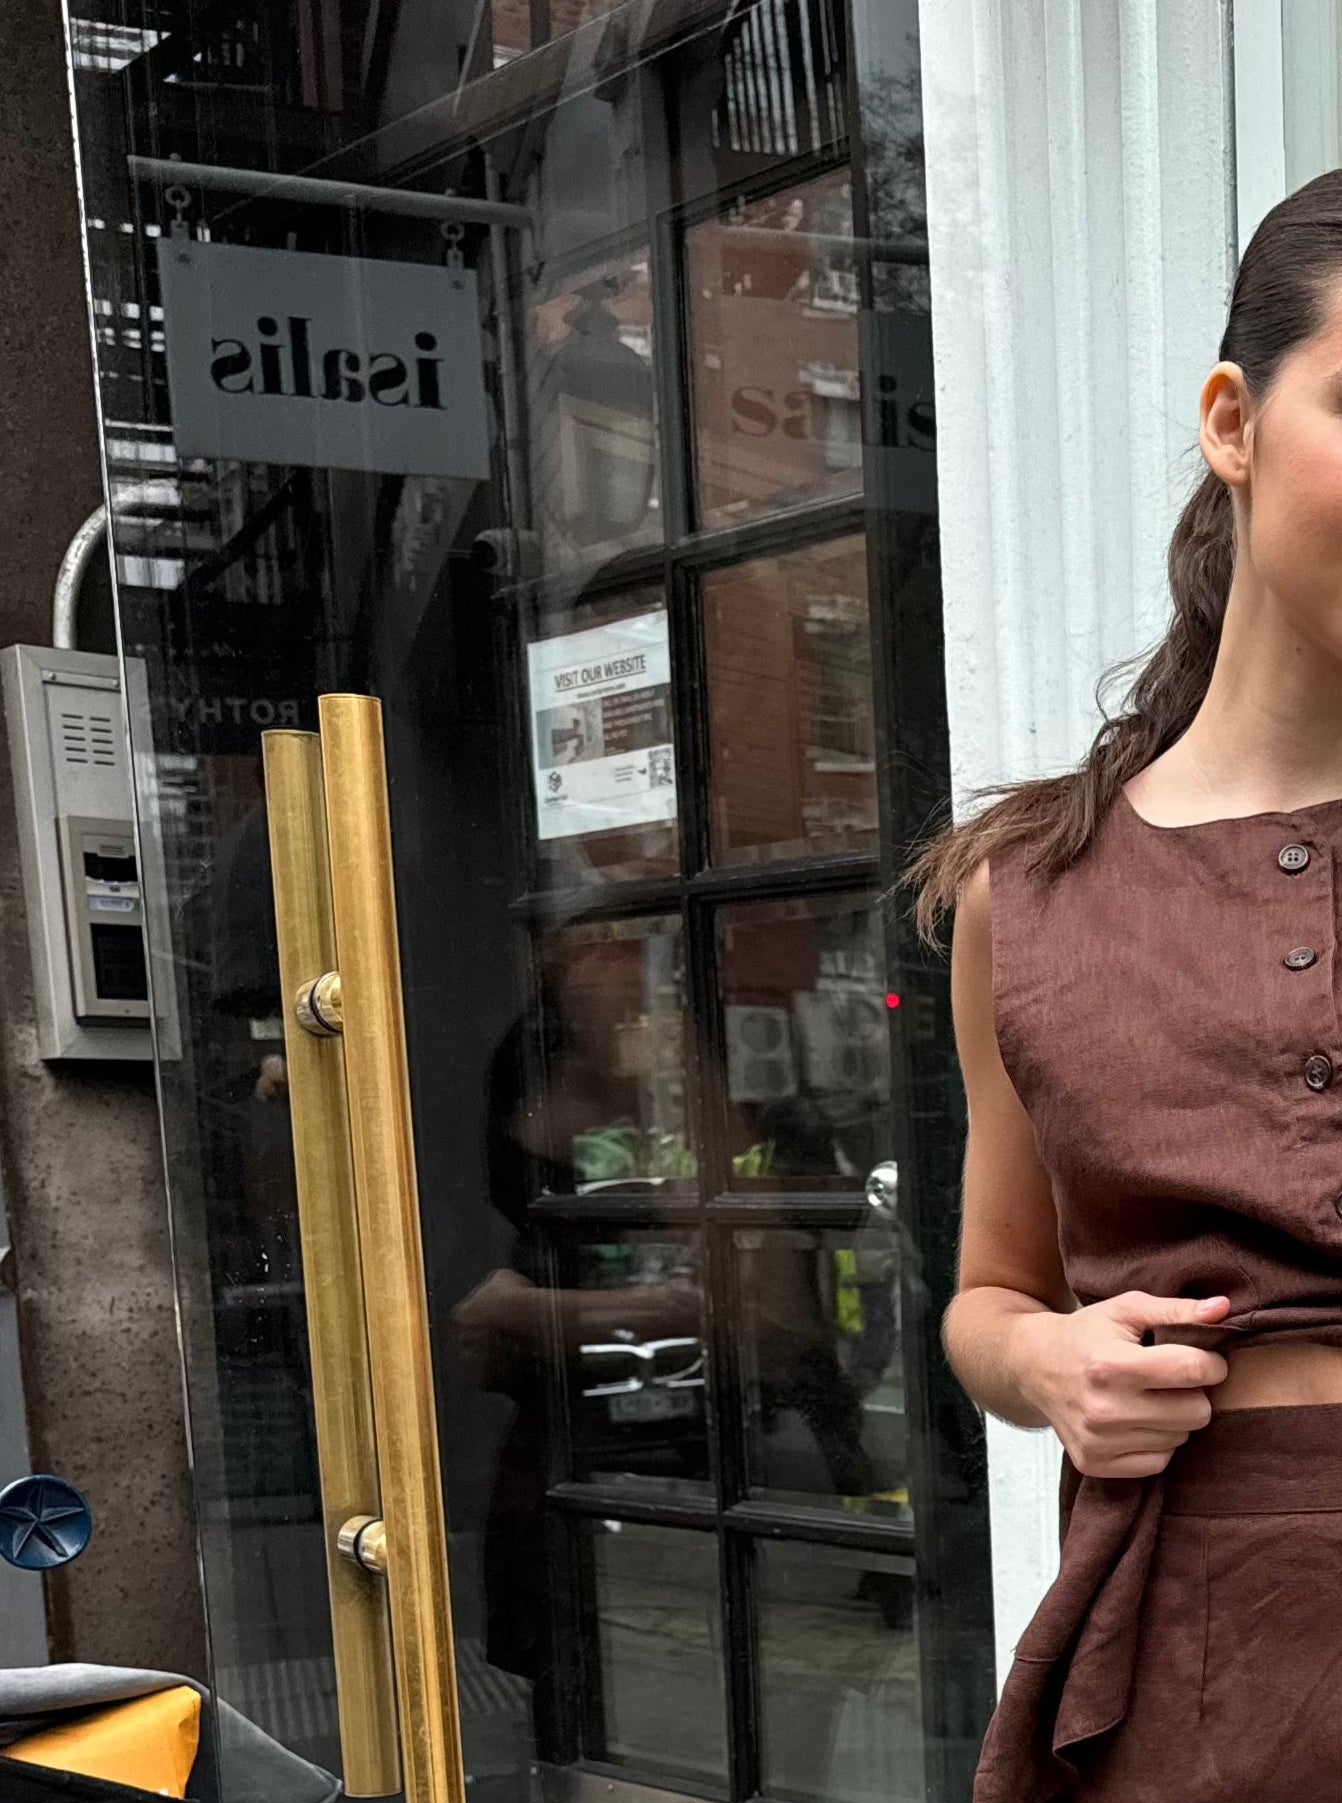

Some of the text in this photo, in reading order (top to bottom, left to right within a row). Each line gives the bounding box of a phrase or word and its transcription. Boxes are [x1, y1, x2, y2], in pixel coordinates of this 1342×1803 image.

[554, 654, 647, 689] VISIT OUR WEBSITE
